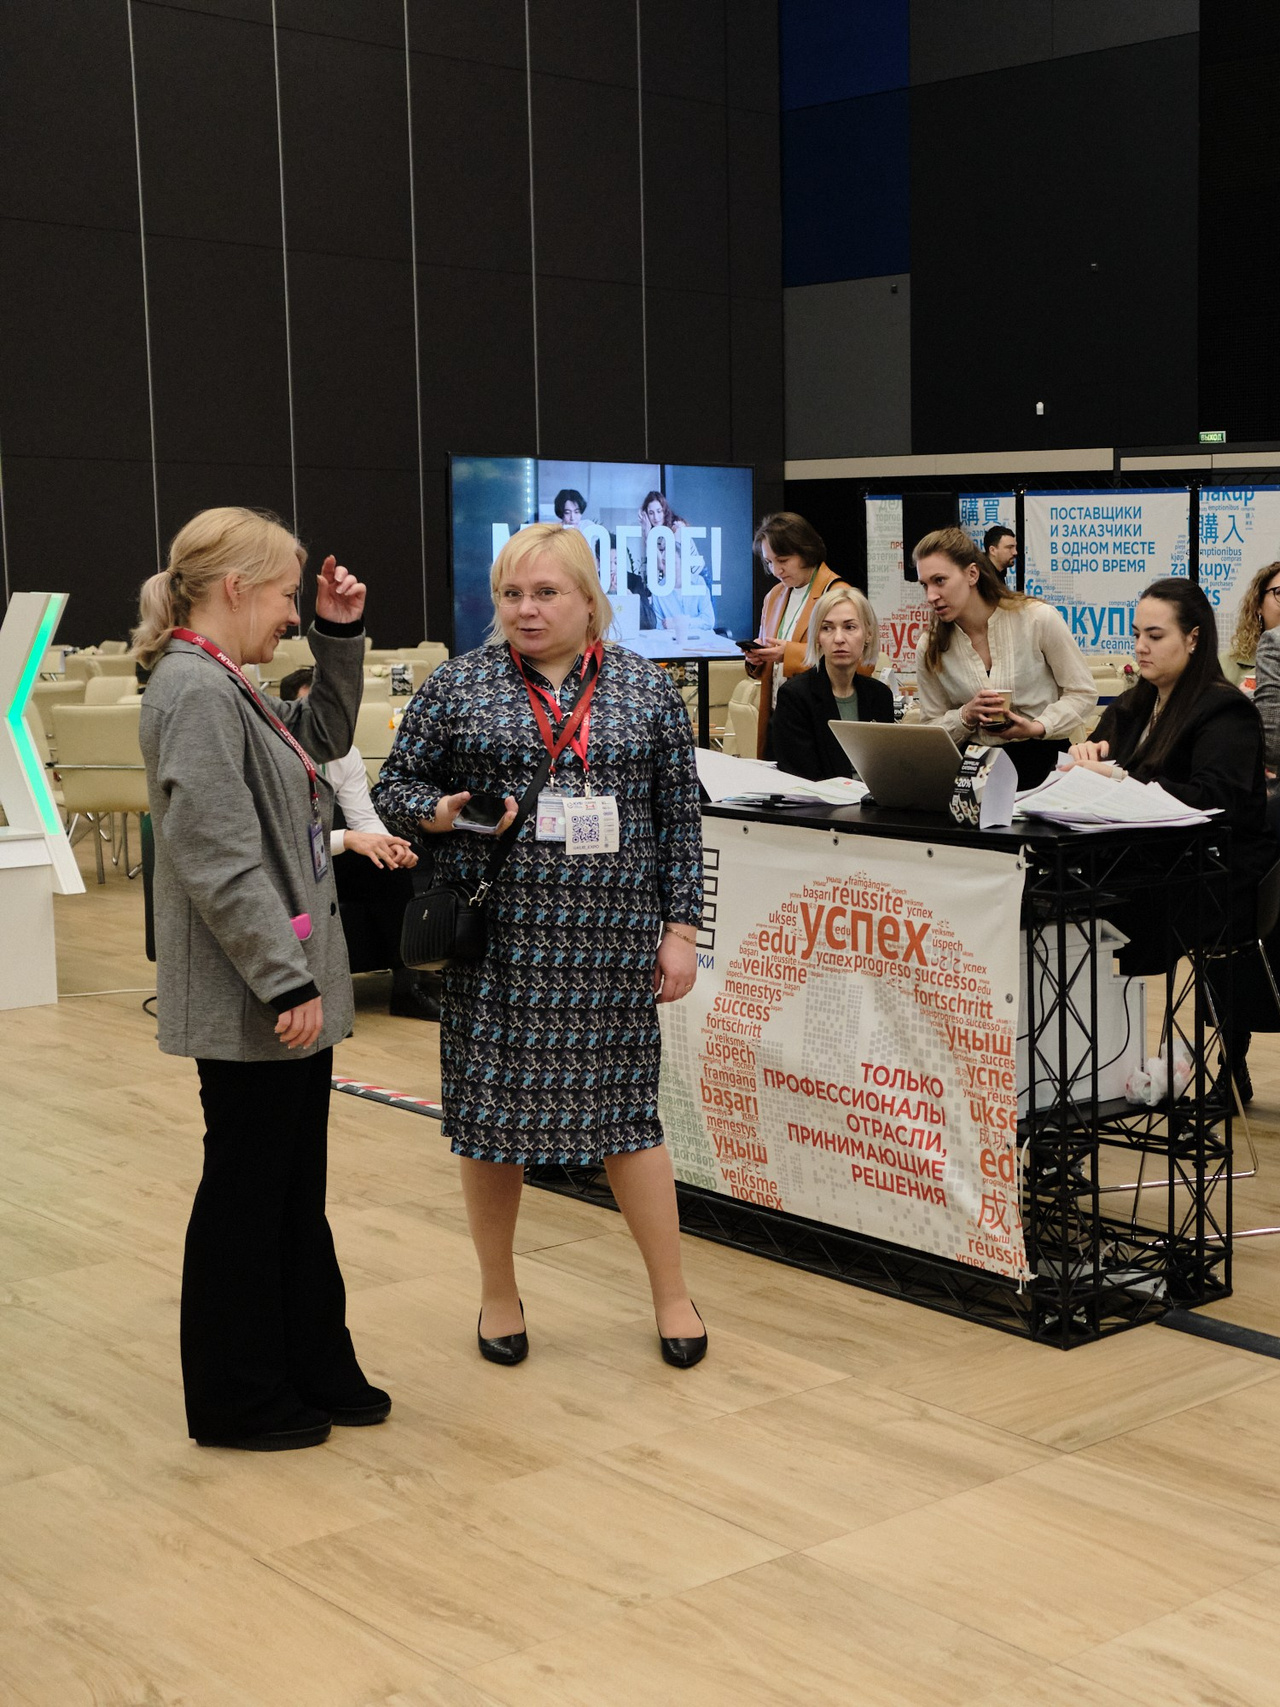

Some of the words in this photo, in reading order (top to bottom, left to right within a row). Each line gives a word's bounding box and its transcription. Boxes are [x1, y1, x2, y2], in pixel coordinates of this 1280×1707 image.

[1050, 506, 1142, 521] ПОСТАВЩИКИ
[1050, 525, 1059, 537] И
[1062, 524, 1142, 537] ЗАКАЗЧИКИ
[1050, 542, 1058, 555] В
[1062, 542, 1109, 557] ОДНОМ
[1112, 541, 1155, 555] МЕСТЕ
[1050, 559, 1058, 571] В
[1062, 559, 1099, 574] ОДНО
[1102, 559, 1146, 572] ВРЕМЯ
[803, 885, 831, 902] başarı
[832, 880, 903, 915] réussite
[769, 910, 797, 926] ukses
[781, 901, 798, 914] edu
[907, 906, 933, 919] успех
[758, 926, 796, 956] edu
[800, 901, 931, 967] успех
[834, 925, 850, 936] edu
[931, 928, 955, 938] veiksme
[739, 945, 759, 957] başarı
[932, 936, 963, 953] úspech
[729, 960, 742, 969] edu
[742, 955, 807, 985] veiksme
[816, 951, 854, 967] успех
[962, 962, 987, 974] успех
[854, 954, 911, 978] progreso
[914, 967, 977, 993] successo
[725, 979, 782, 1004] menestys
[914, 984, 993, 1020] fortschritt
[977, 985, 991, 995] edu
[713, 996, 771, 1022] success
[706, 1013, 762, 1038] fortschritt
[965, 1020, 1000, 1031] successo
[706, 1036, 756, 1065] úspech
[714, 1033, 745, 1047] veiksme
[945, 1022, 1011, 1056] уңыш
[861, 1062, 944, 1098] ТОЛЬКО
[966, 1063, 1016, 1091] успе
[700, 1078, 759, 1116] başarı
[763, 1068, 946, 1126] ПРОФЕССИОНАЛЫ
[706, 1115, 757, 1140] menestys
[846, 1113, 947, 1158] ОТРАСЛИ,
[669, 1131, 711, 1151] закупки
[712, 1133, 768, 1164] уңыш
[787, 1122, 946, 1181] ПРИНИМАЮЩИЕ
[673, 1147, 715, 1170] договор
[675, 1167, 718, 1190] товар
[721, 1166, 778, 1195] veiksme
[851, 1163, 947, 1207] РЕШЕНИЯ
[730, 1184, 784, 1211] поспех
